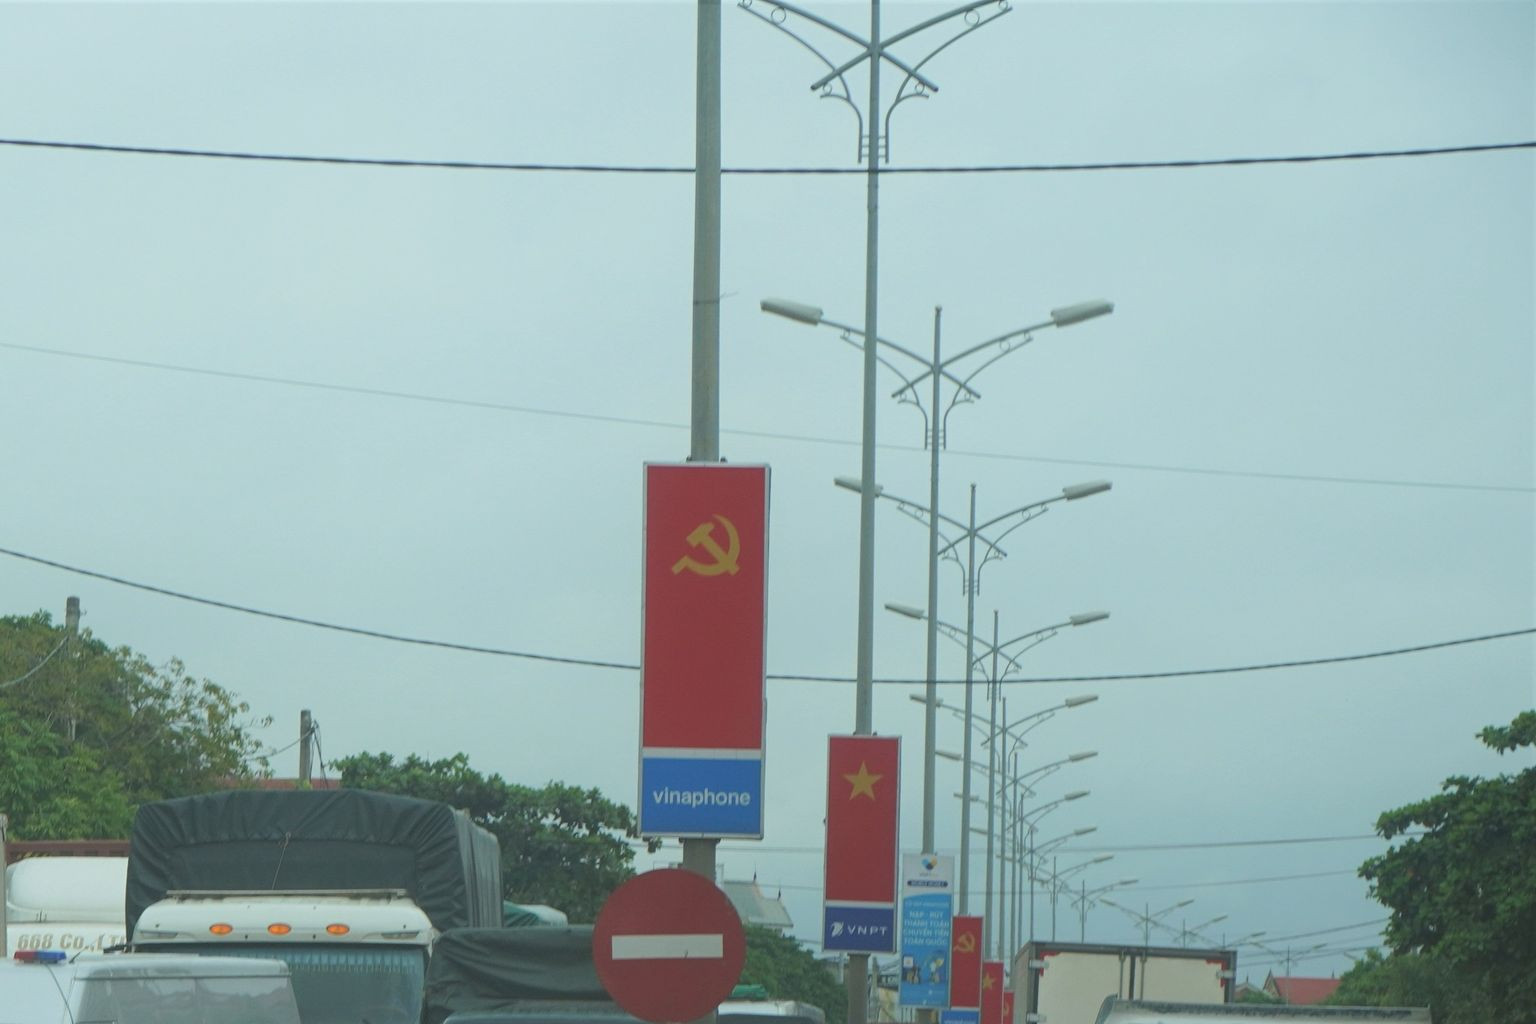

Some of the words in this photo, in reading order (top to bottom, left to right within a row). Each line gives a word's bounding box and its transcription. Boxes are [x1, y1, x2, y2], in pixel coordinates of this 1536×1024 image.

[652, 786, 752, 809] vinaphone
[846, 924, 889, 937] VNPT
[16, 933, 54, 950] 668
